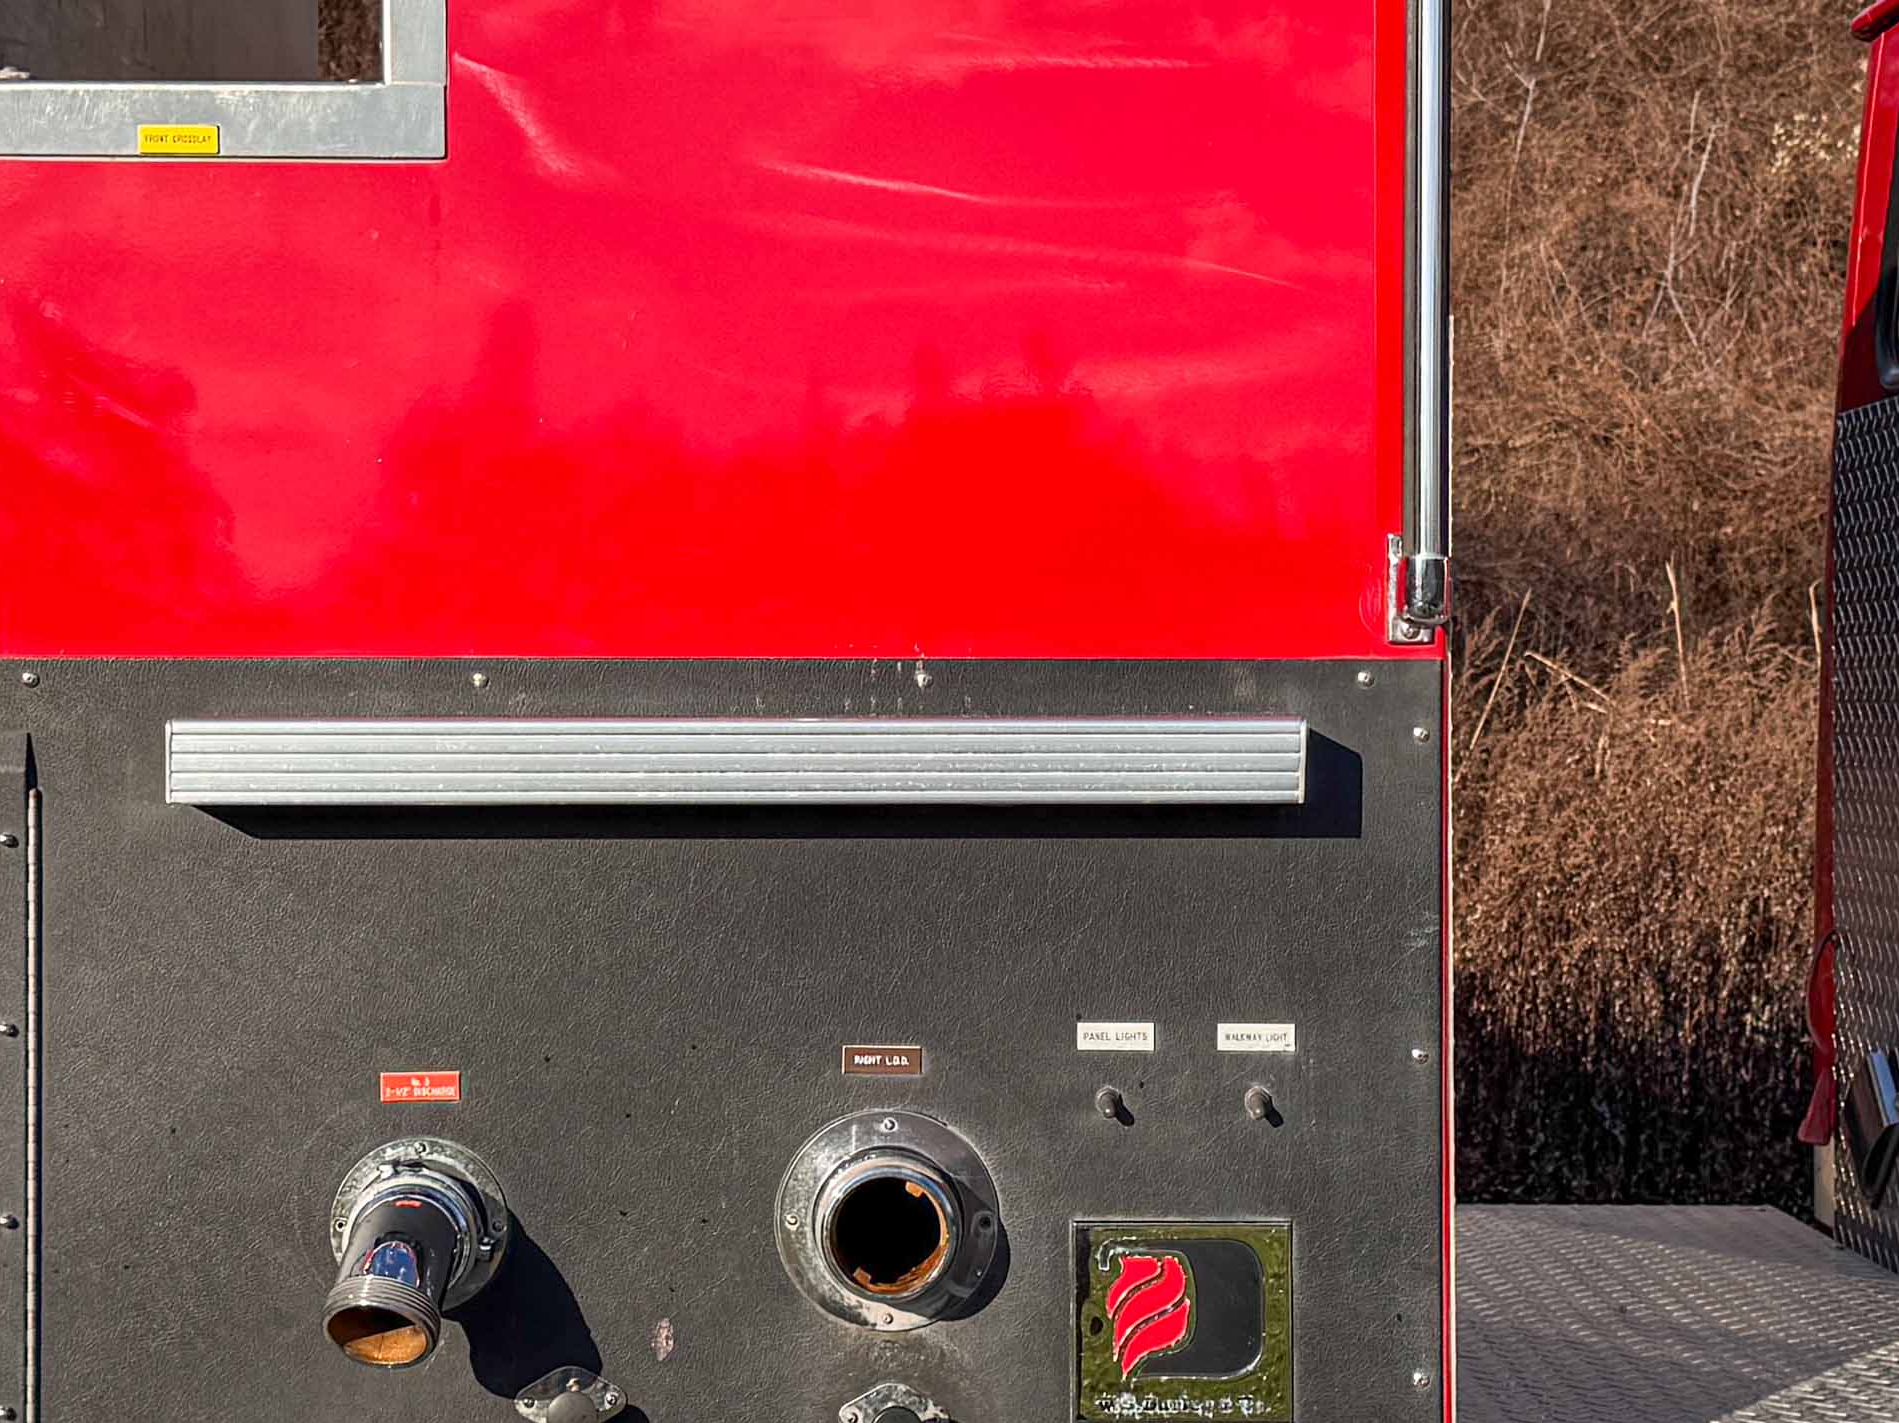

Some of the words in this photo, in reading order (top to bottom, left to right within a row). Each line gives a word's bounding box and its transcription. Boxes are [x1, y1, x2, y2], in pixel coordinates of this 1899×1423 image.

[1083, 1031, 1111, 1041] PANEL
[1115, 1031, 1148, 1041] LIGHTS
[1265, 1032, 1288, 1042] LIGHT
[854, 1054, 883, 1065] RIGHT
